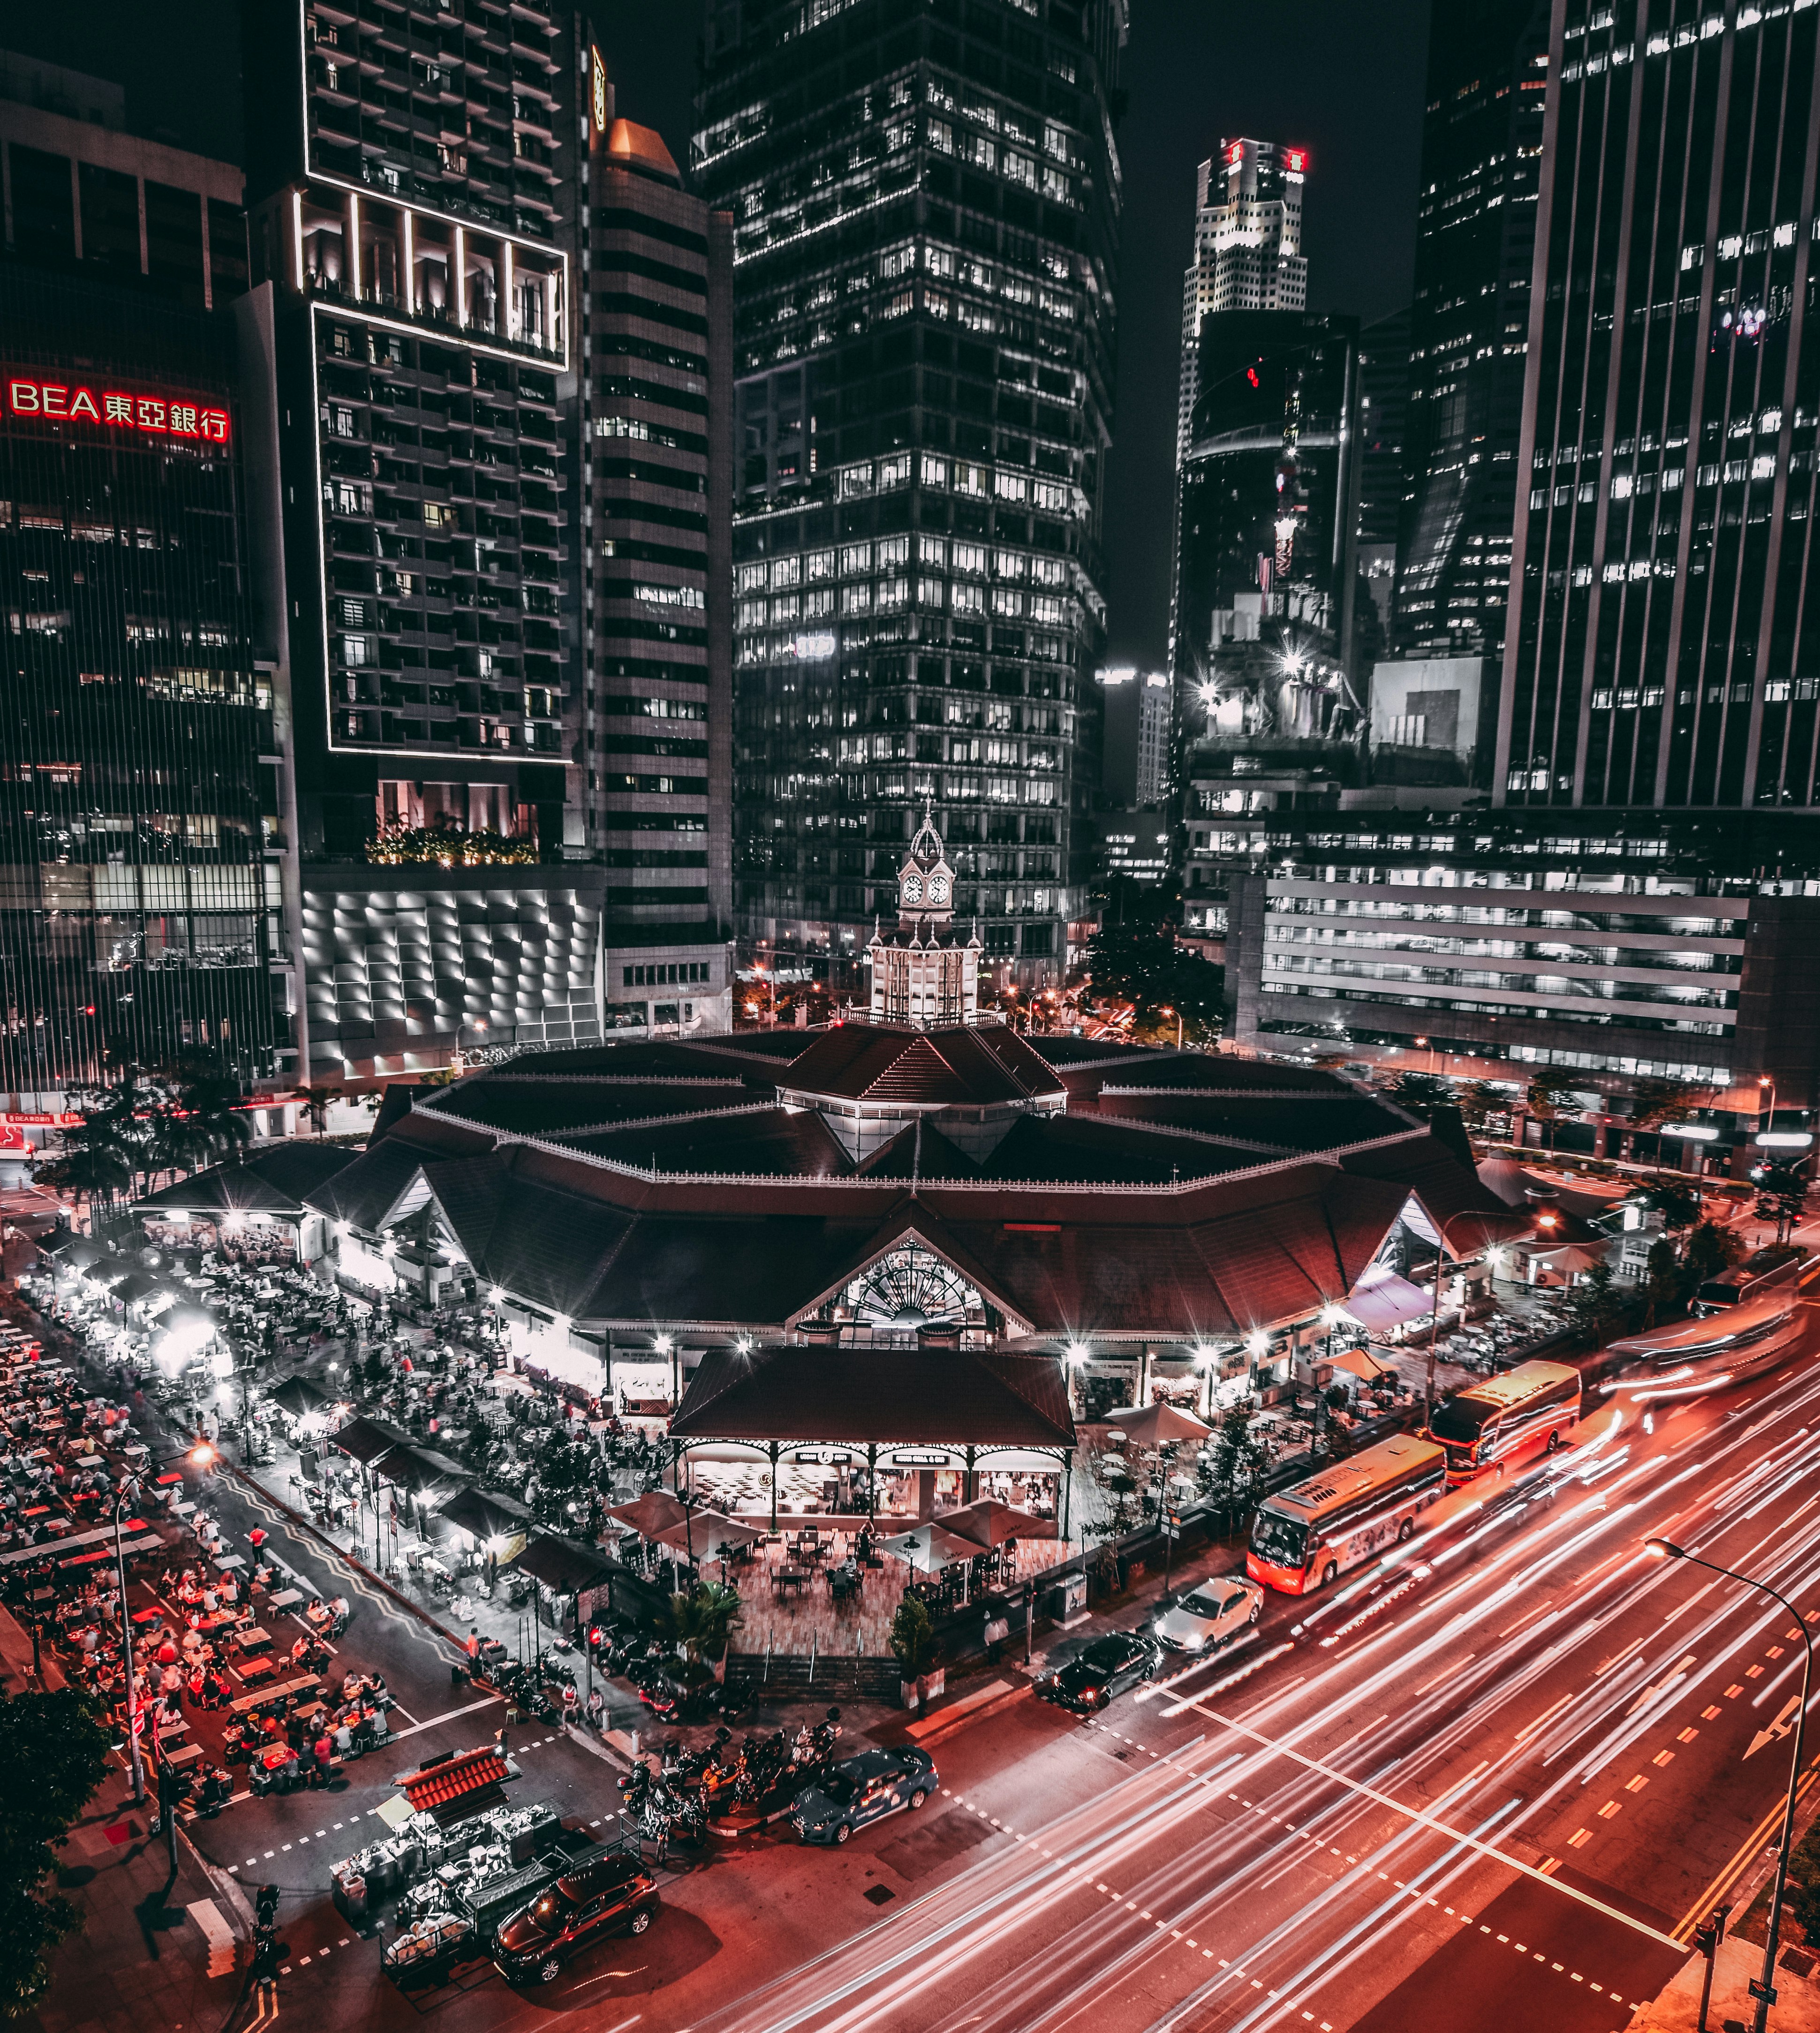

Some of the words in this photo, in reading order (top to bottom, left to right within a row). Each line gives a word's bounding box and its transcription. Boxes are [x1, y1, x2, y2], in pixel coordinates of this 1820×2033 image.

[12, 383, 99, 419] BEA
[105, 395, 227, 438] 東亞銀行
